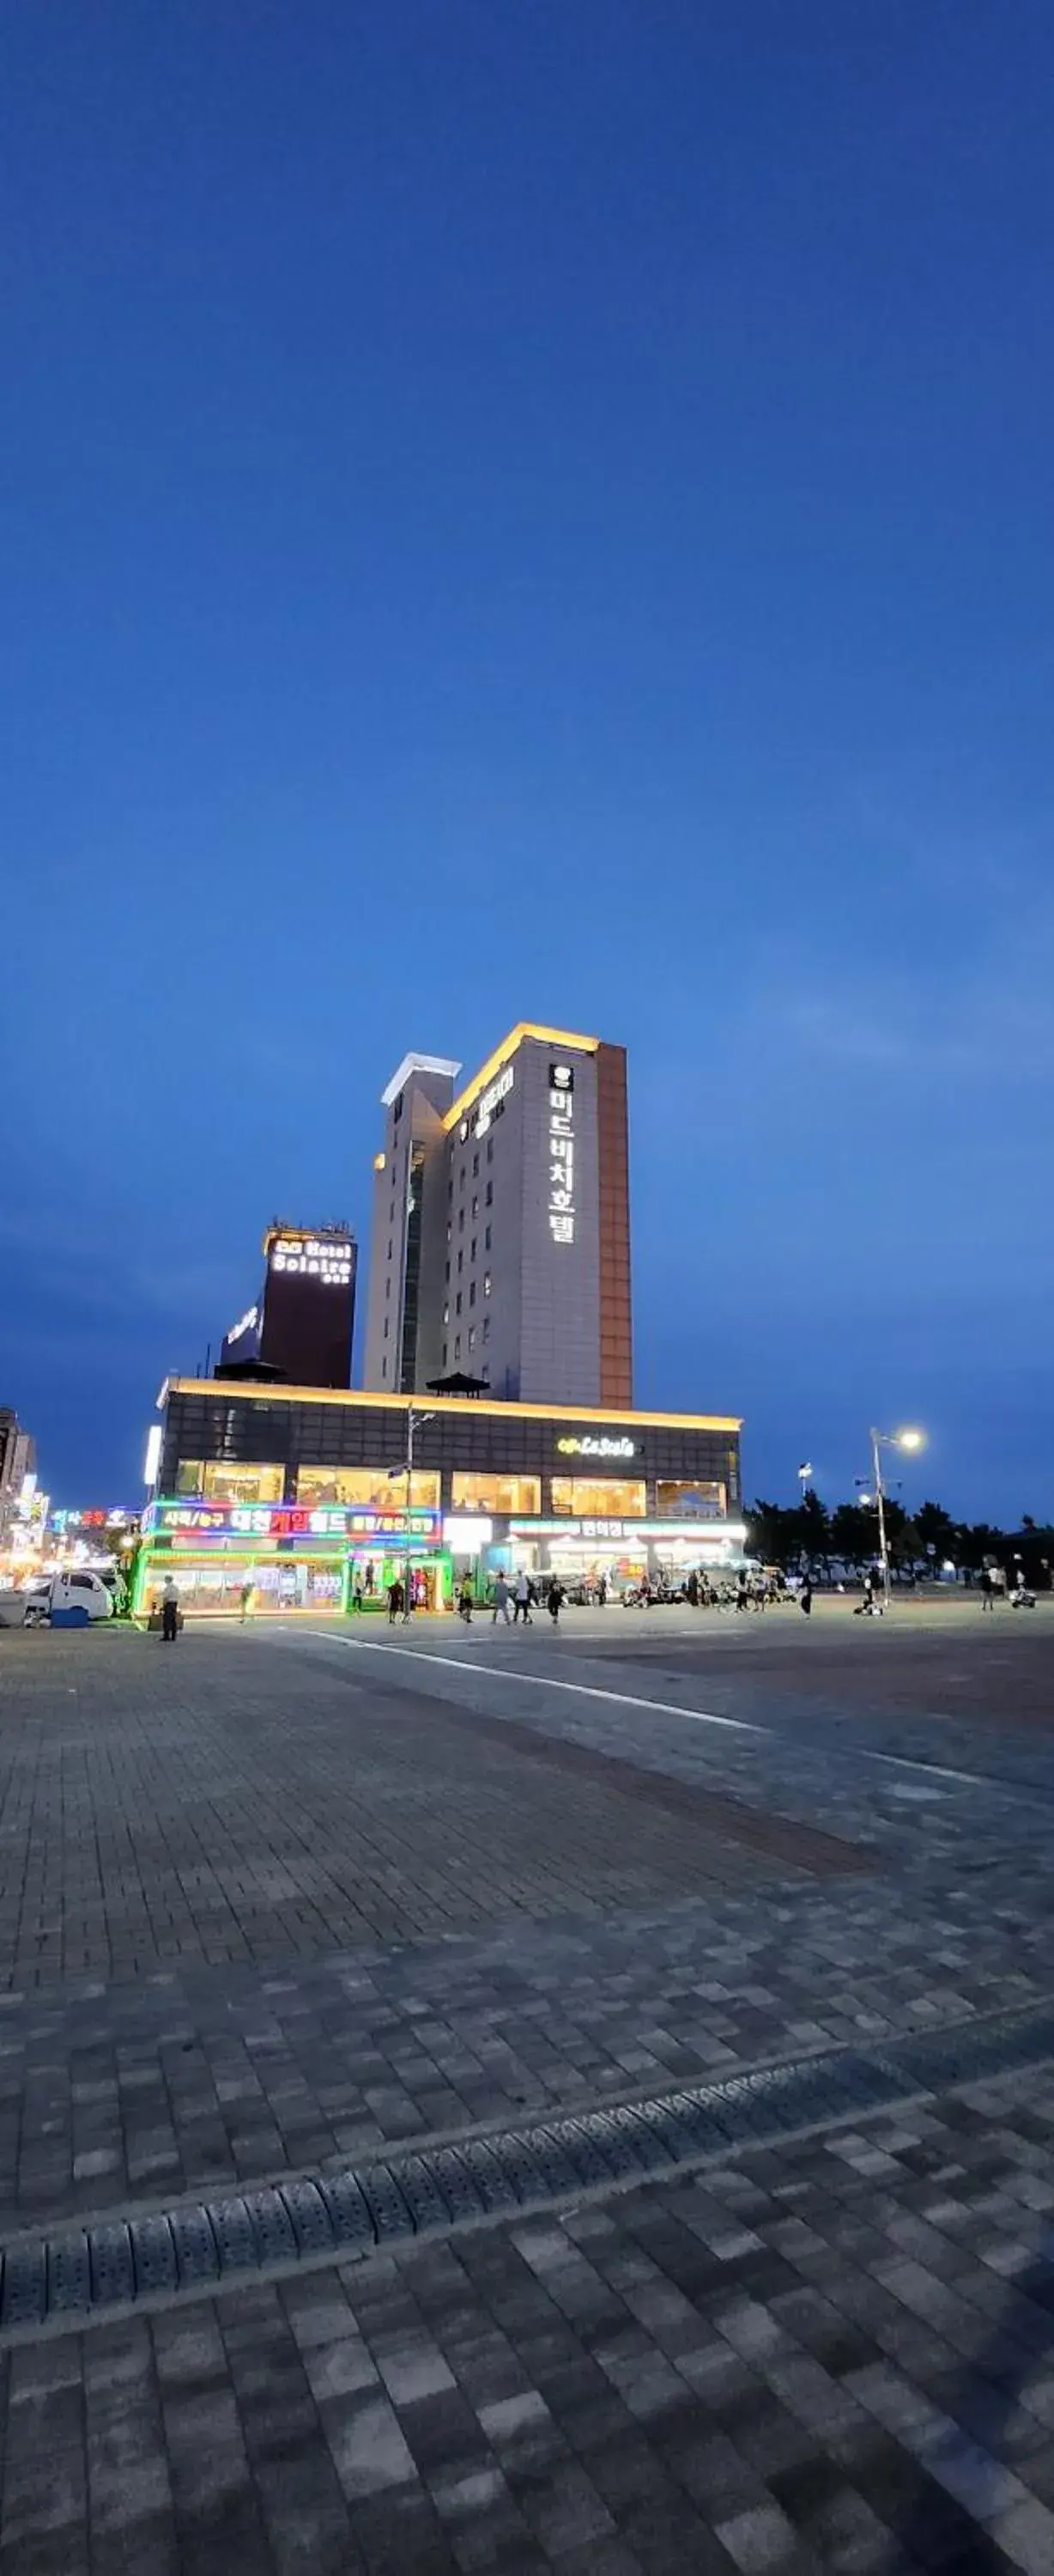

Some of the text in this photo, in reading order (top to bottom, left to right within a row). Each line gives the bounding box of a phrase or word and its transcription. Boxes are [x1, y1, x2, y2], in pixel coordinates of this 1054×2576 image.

[548, 1091, 575, 1243] 머드비치호텔
[306, 1242, 351, 1258] Hotel
[273, 1255, 351, 1274] Solaire
